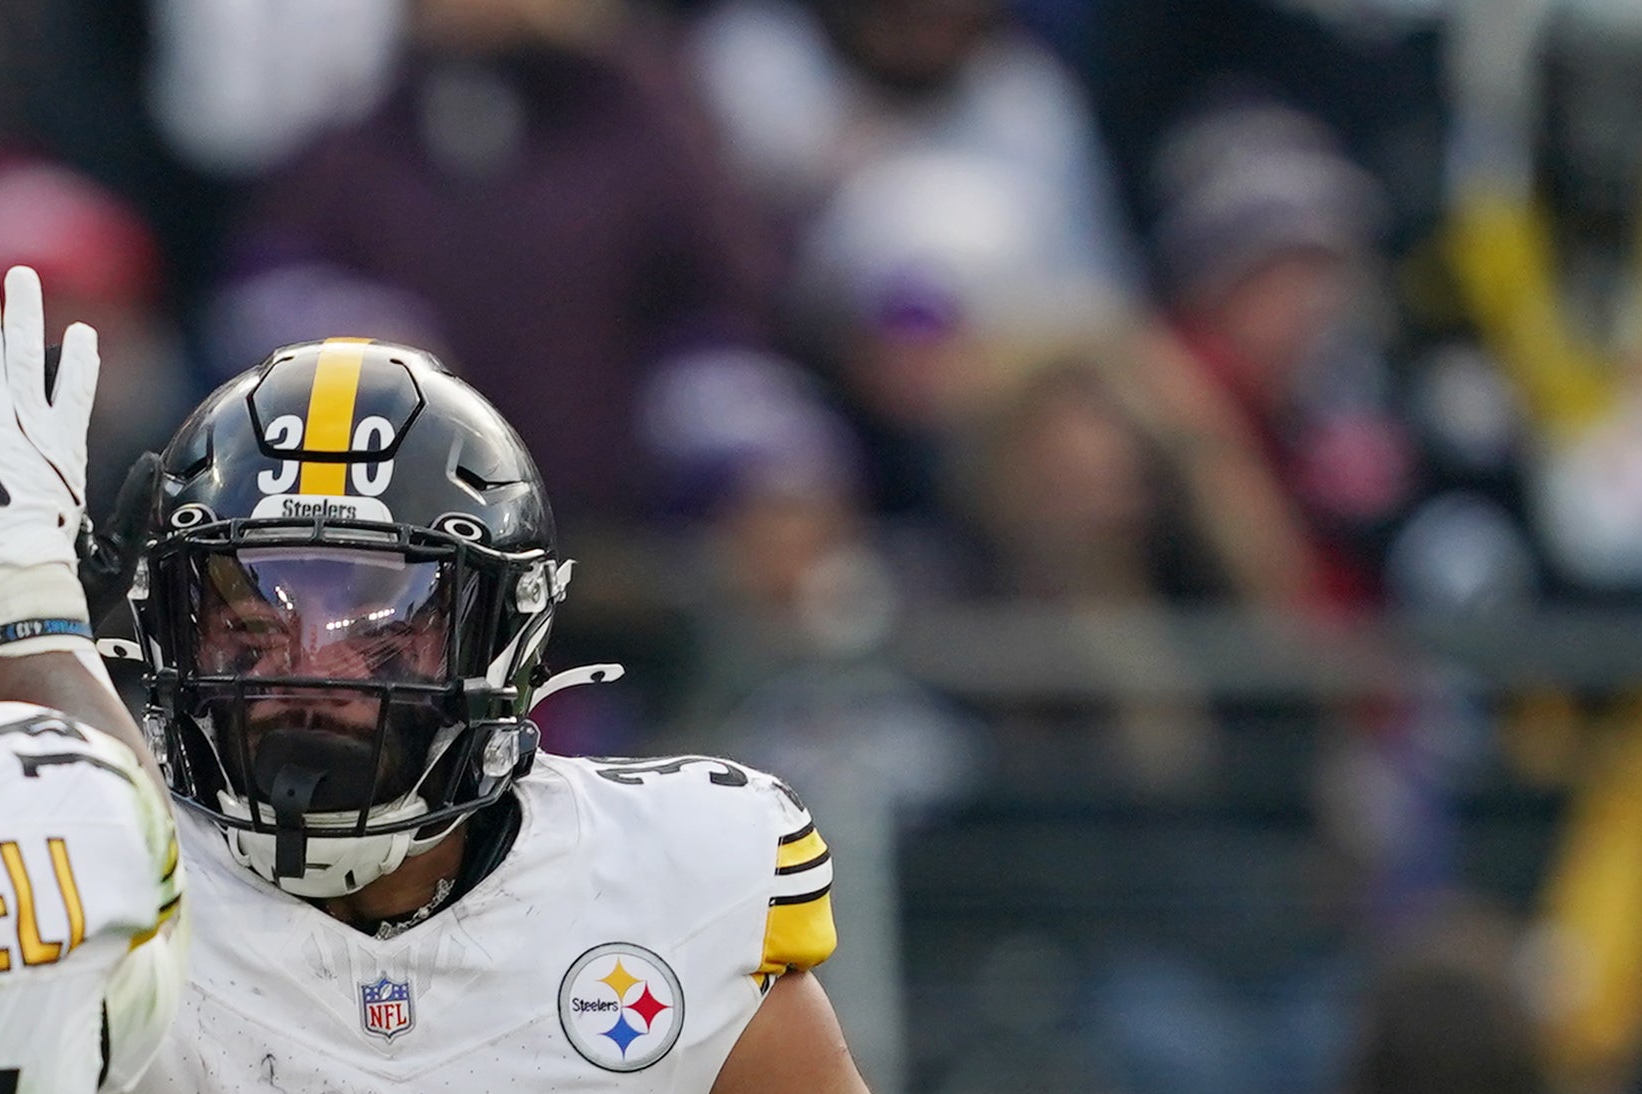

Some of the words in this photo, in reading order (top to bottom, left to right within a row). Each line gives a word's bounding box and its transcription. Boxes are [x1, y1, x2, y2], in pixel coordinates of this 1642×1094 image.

[257, 414, 396, 497] 30
[281, 499, 357, 519] Steelers
[369, 1003, 408, 1030] NFL
[571, 997, 619, 1013] Steelers
